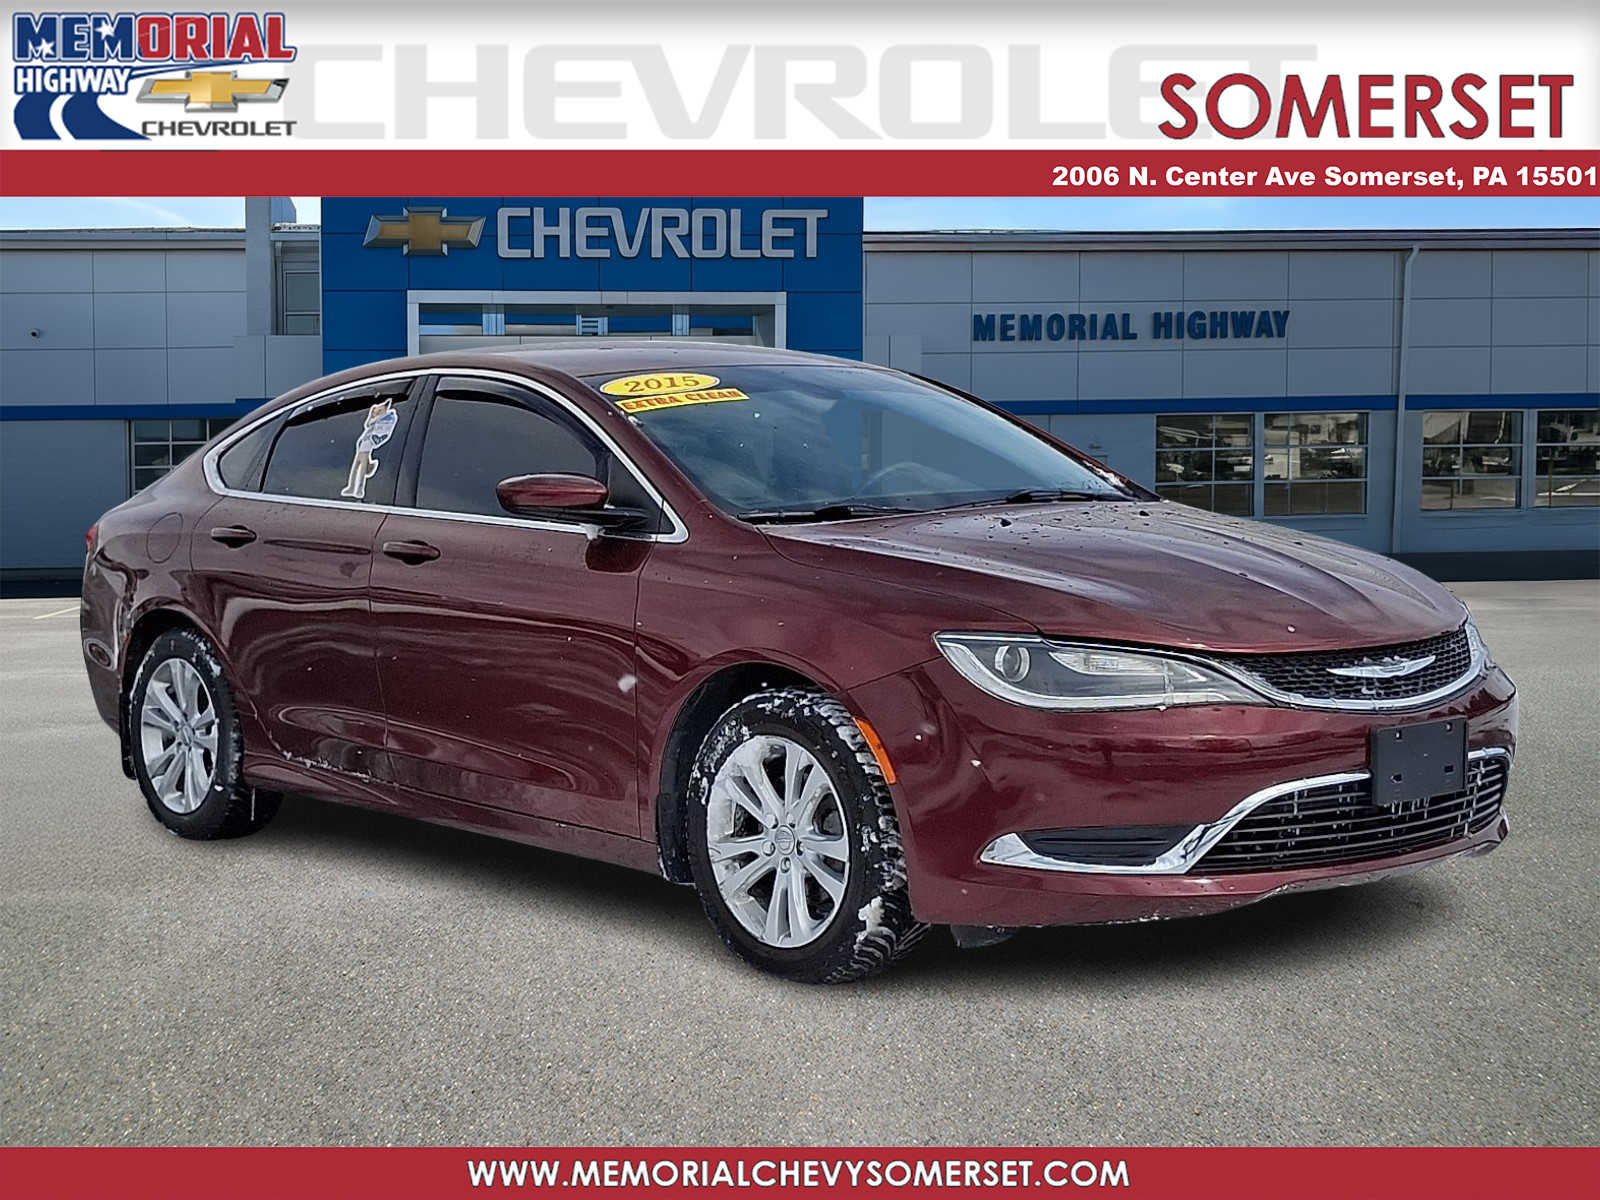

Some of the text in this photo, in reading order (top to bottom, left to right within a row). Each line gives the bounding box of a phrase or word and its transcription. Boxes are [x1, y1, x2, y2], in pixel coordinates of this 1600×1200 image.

[497, 207, 828, 259] CHEVROLET
[973, 310, 1290, 341] MEMORIAL HIGHWAY
[624, 376, 700, 393] 2015
[622, 390, 742, 410] EXTRA CLEAN
